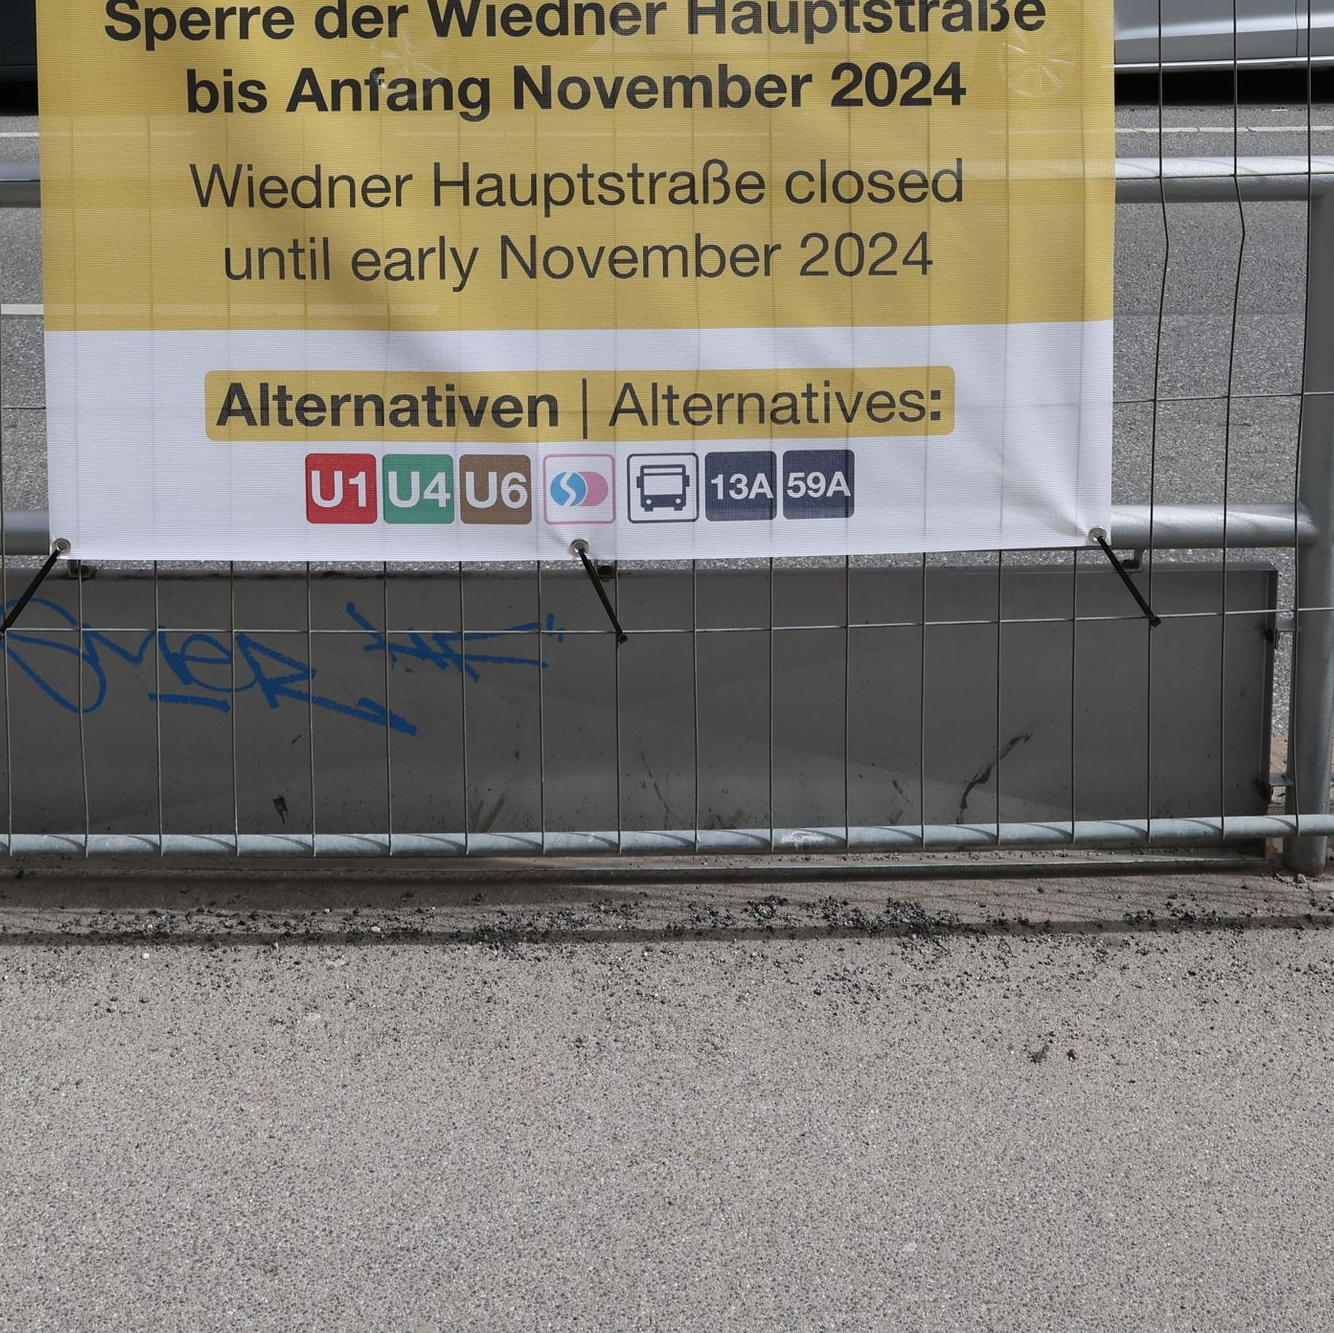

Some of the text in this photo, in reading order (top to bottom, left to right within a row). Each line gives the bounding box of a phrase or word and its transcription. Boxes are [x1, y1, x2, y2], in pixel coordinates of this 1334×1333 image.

[187, 62, 966, 122] bis Anfang November 2024
[190, 158, 962, 216] Wiedner Hauptstraße closed
[225, 232, 933, 292] until early November 2024
[216, 383, 558, 428] Alternativen
[609, 380, 940, 426] Alternatives:
[312, 471, 851, 508] U1 U4 U6 13A 59A
